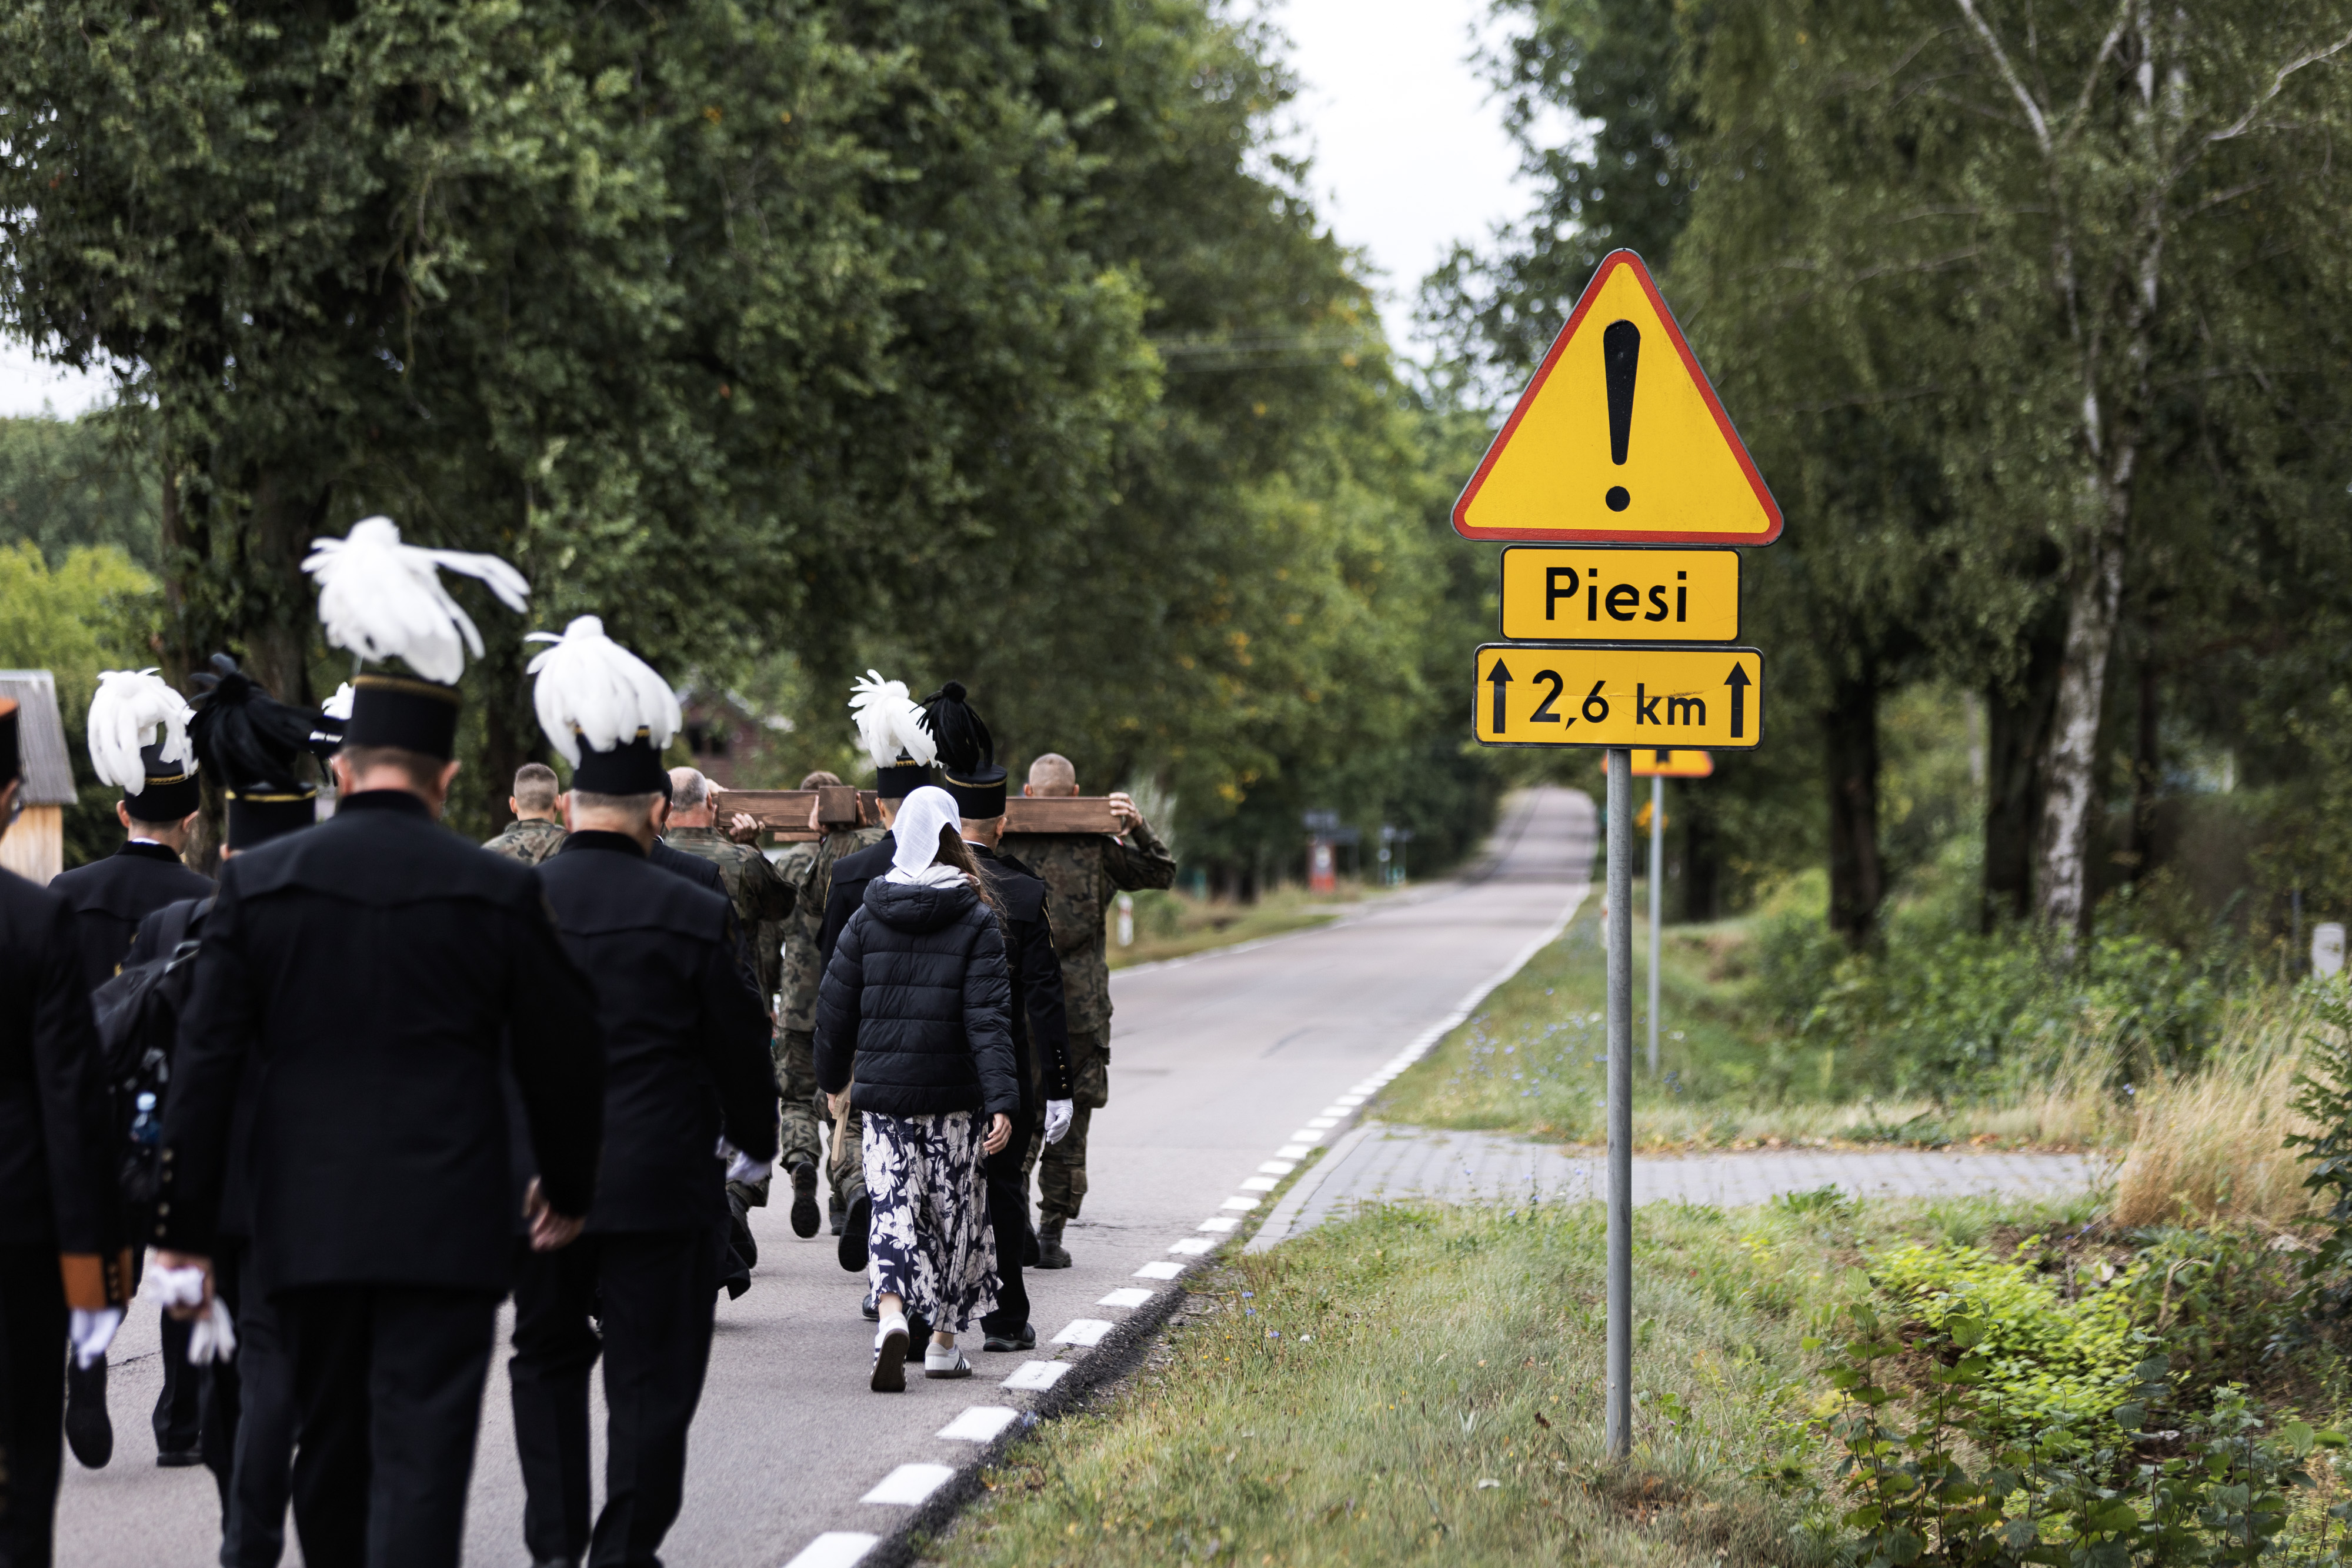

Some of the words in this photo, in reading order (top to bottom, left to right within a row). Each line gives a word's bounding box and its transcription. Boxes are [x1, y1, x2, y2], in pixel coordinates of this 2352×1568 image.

[1546, 567, 1687, 622] Piesi
[1530, 669, 1609, 731] 2,6
[1636, 683, 1706, 726] km
